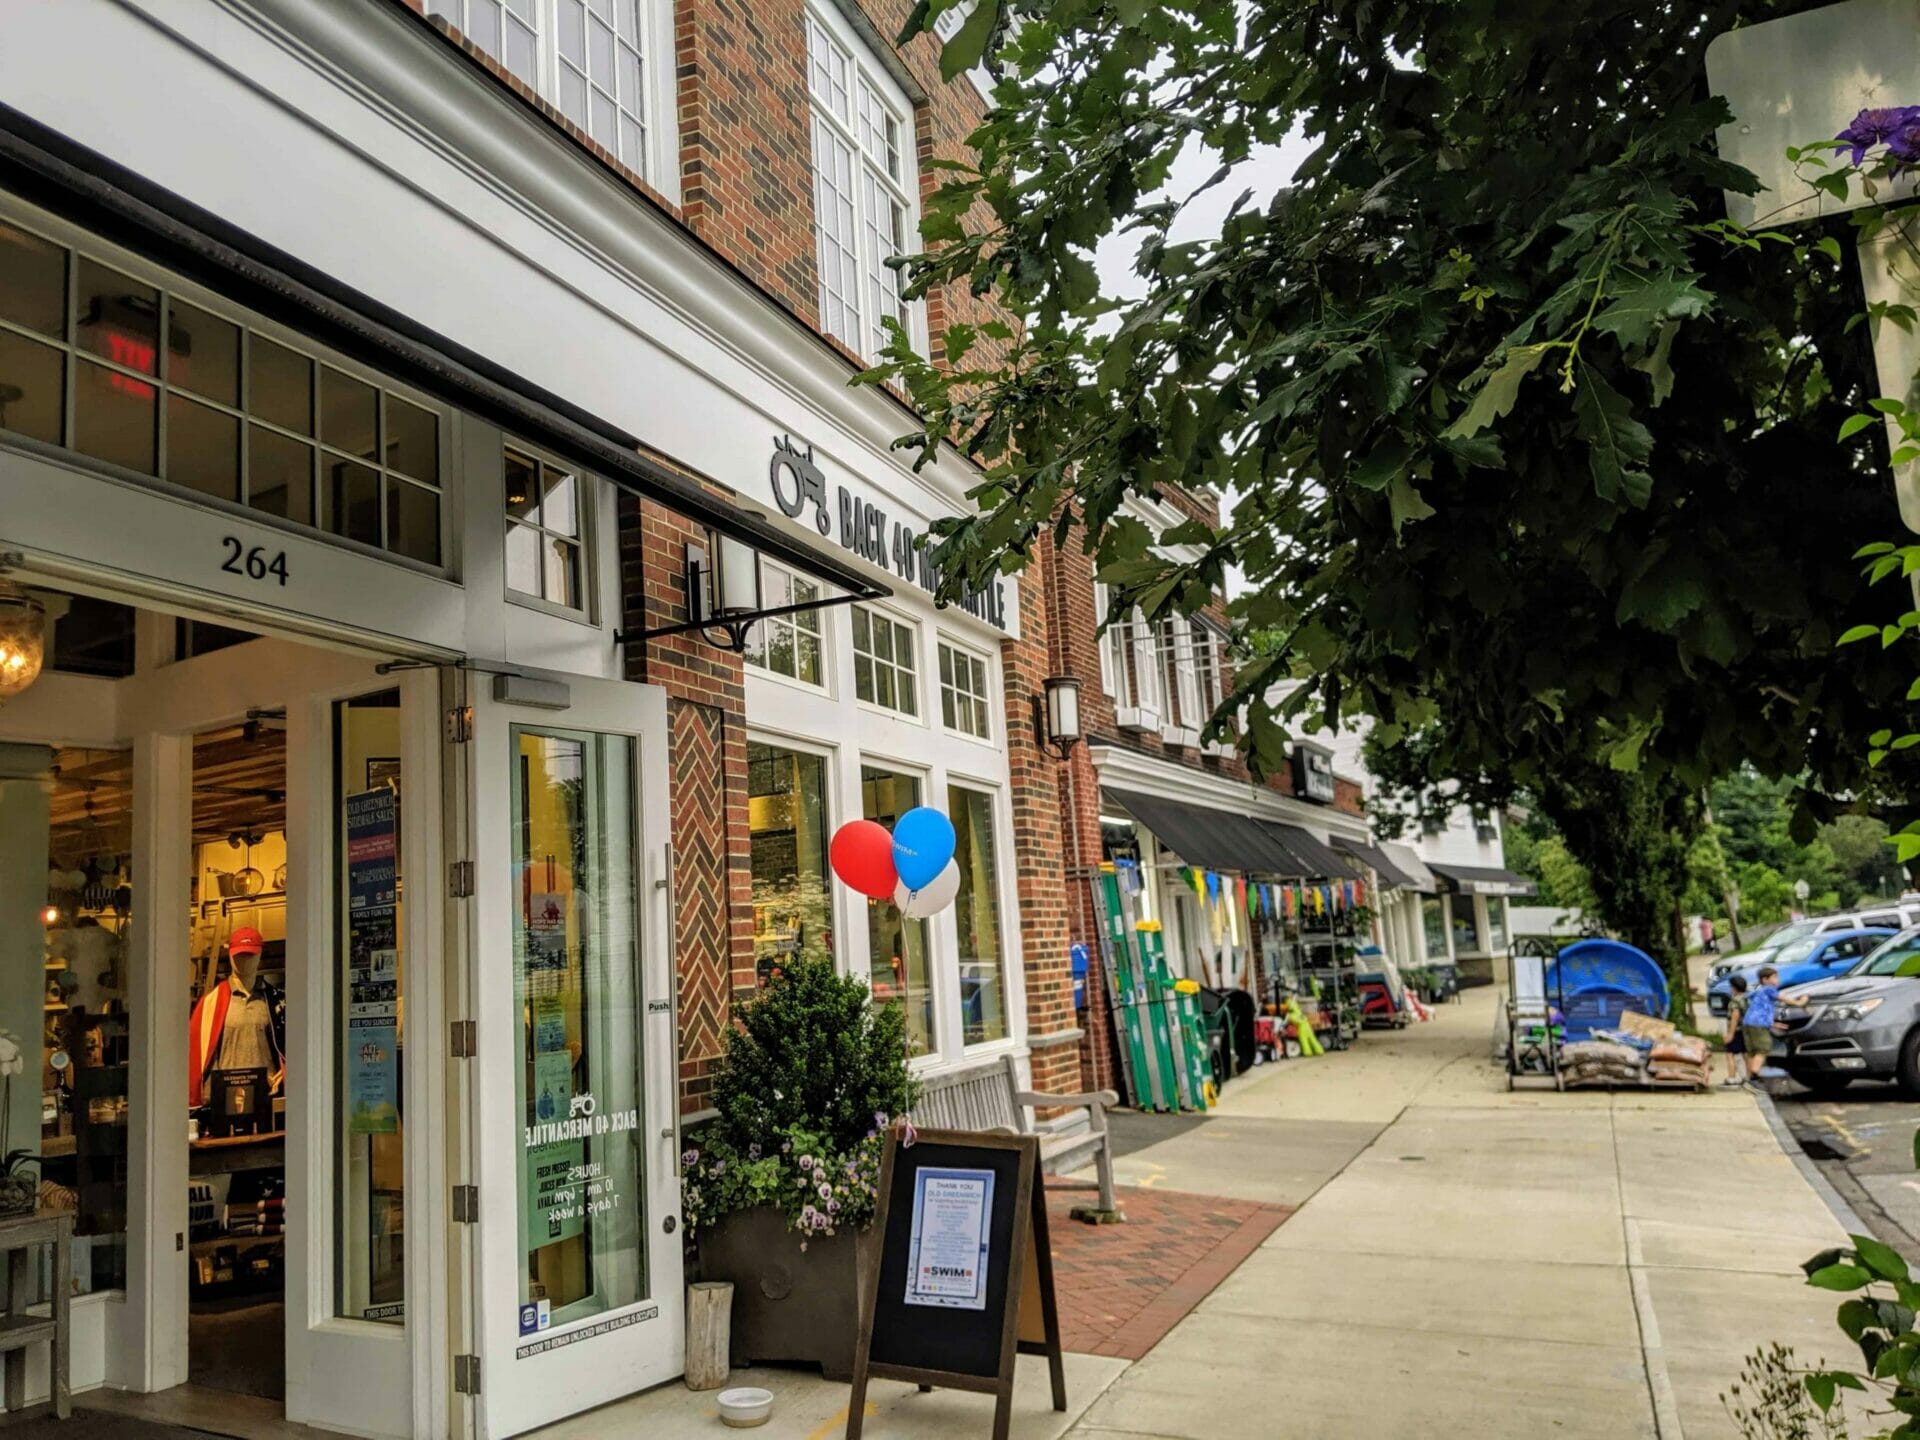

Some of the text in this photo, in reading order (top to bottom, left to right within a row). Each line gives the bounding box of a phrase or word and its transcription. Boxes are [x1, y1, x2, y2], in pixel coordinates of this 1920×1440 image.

[838, 485, 889, 570] BACK
[893, 521, 915, 583] 40
[221, 536, 289, 587] 264
[352, 910, 370, 919] FAMILY
[649, 1002, 669, 1011] Push
[931, 1266, 965, 1277] SWIM
[366, 1309, 379, 1319] THIS
[380, 1306, 397, 1316] DOOR
[518, 1347, 530, 1358] THIS
[530, 1343, 544, 1355] DOOR
[544, 1340, 551, 1350] TO
[551, 1335, 570, 1349] REMAIN
[570, 1326, 595, 1343] UNLOCKED
[595, 1322, 610, 1335] WHILE
[610, 1315, 631, 1329] BUILDING
[636, 1307, 658, 1321] OCCUPIED
